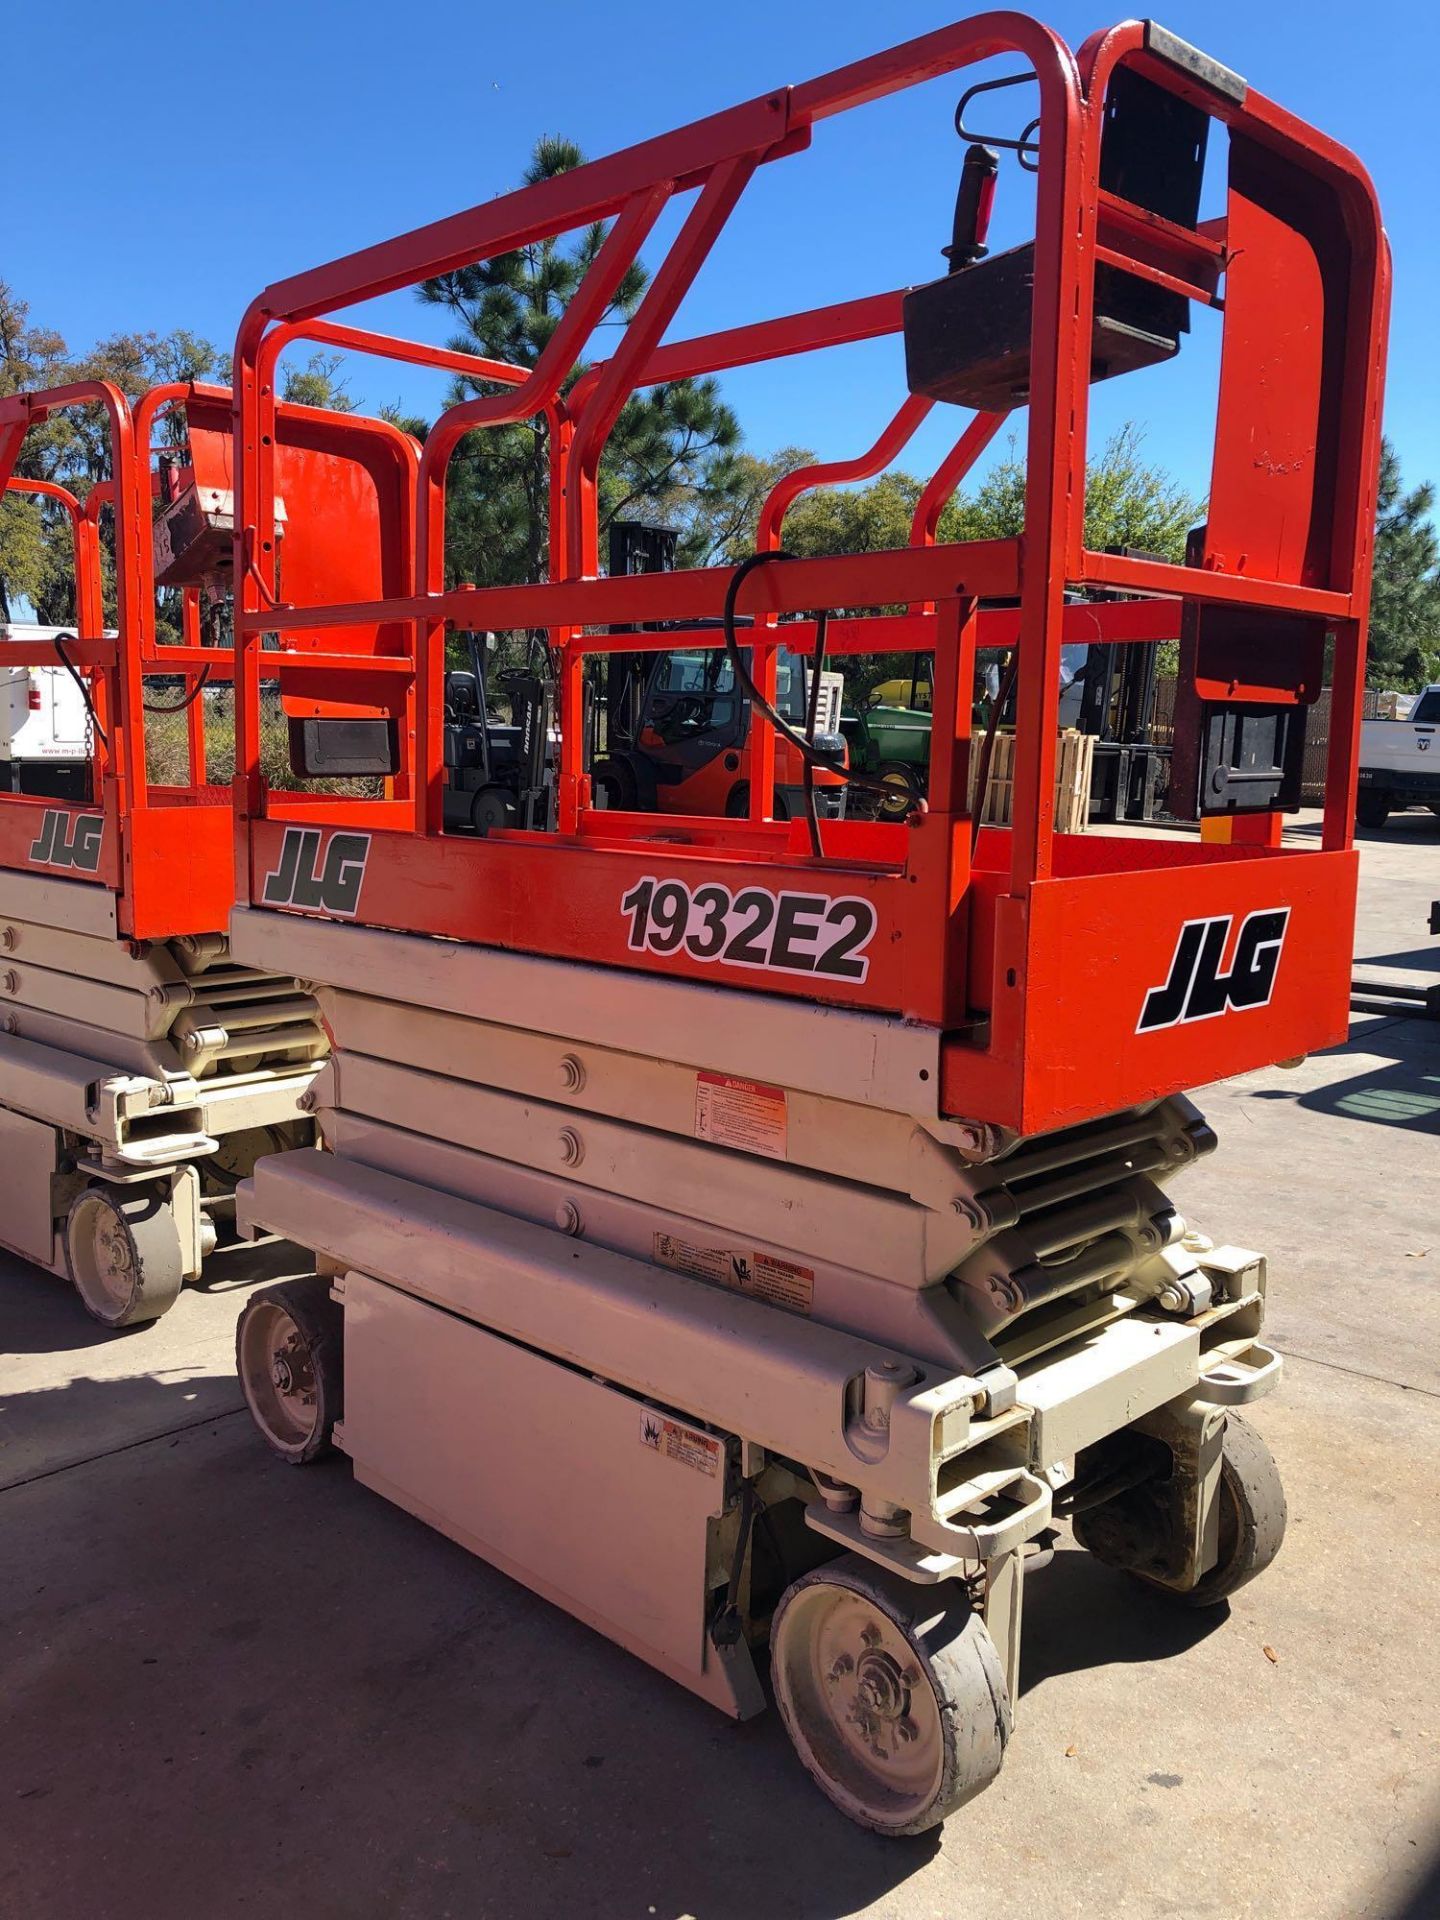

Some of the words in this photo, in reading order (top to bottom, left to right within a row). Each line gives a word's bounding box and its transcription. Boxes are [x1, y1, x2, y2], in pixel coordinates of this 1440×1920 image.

[523, 700, 534, 756] DOOSAN
[29, 808, 105, 873] JLG
[262, 826, 373, 917] JLG
[621, 876, 878, 984] 1932E2
[1134, 906, 1292, 1035] JLG
[732, 1080, 756, 1093] DANGER
